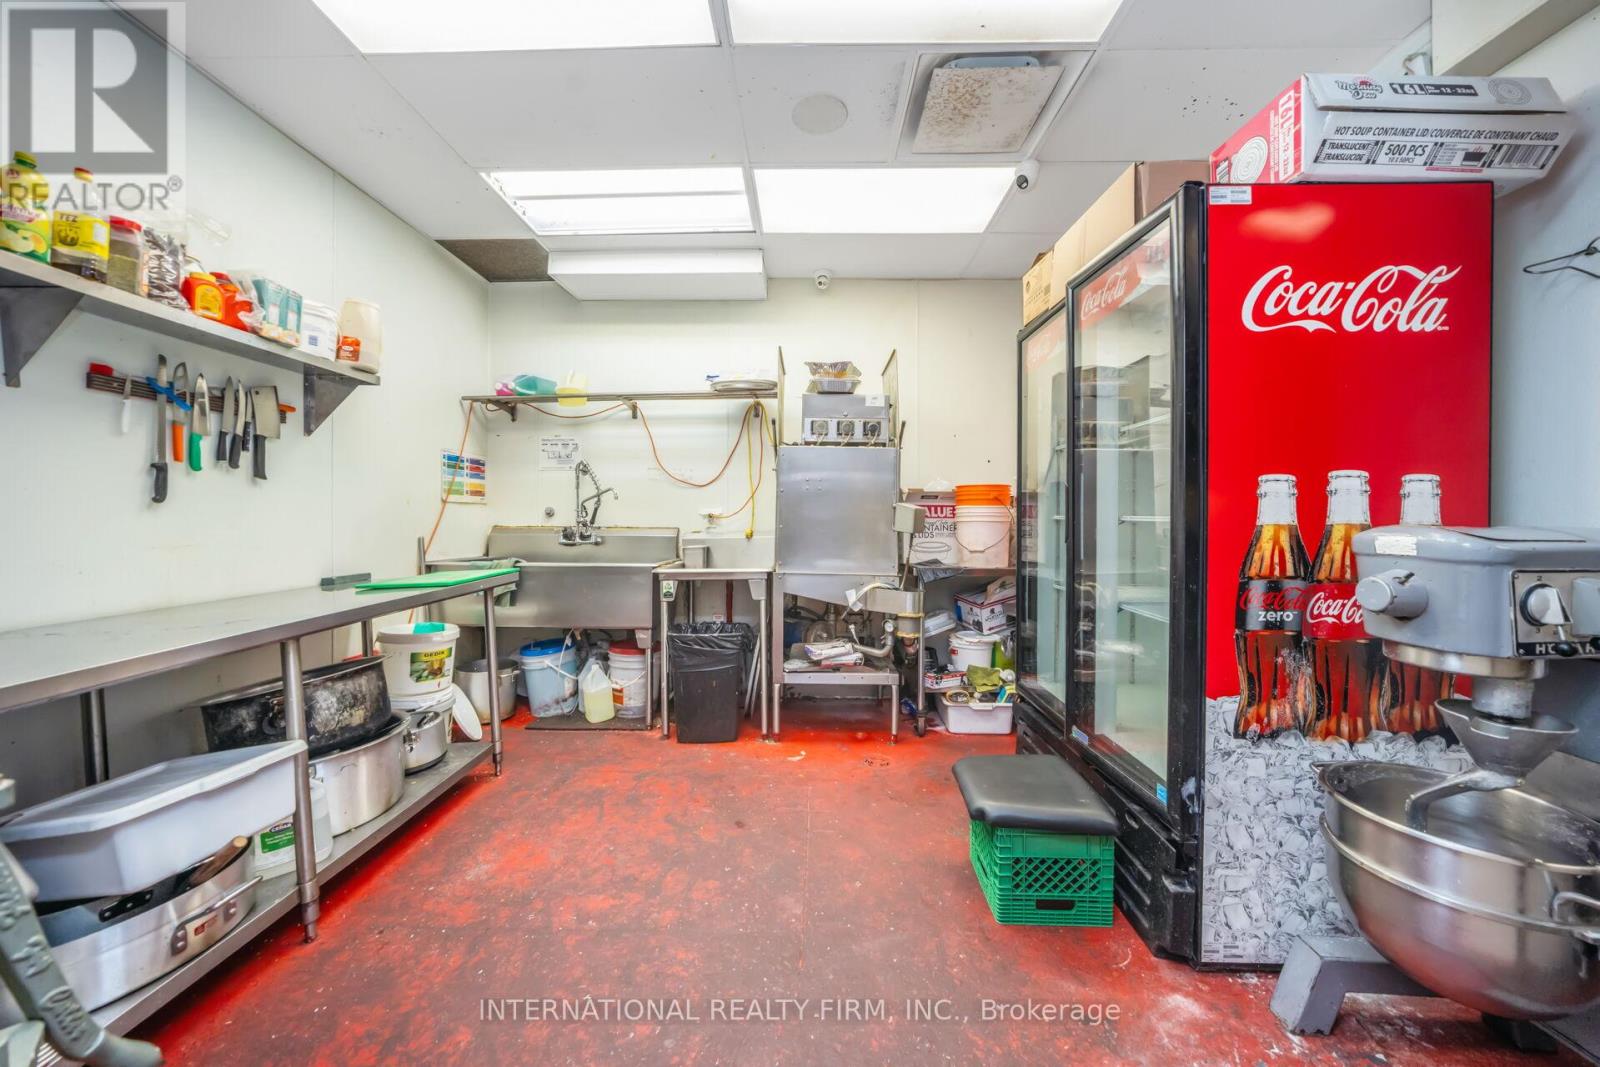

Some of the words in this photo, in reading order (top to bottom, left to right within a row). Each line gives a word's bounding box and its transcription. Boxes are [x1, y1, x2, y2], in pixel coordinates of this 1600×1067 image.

[1334, 126, 1351, 136] HOT
[1350, 126, 1373, 136] SOUP
[1372, 127, 1417, 137] CONTAINER
[1472, 130, 1485, 139] DE
[1483, 130, 1533, 140] CONTENANT
[1529, 132, 1560, 141] CHAUD
[1328, 142, 1372, 150] TRANSLUCENT
[1385, 143, 1407, 156] 500
[1406, 145, 1429, 156] PCS
[1323, 153, 1366, 161] TRANSLUCIDE
[1080, 264, 1129, 321] Coca-Cola
[1241, 264, 1463, 334] Coca-Cola
[1258, 610, 1294, 622] zero
